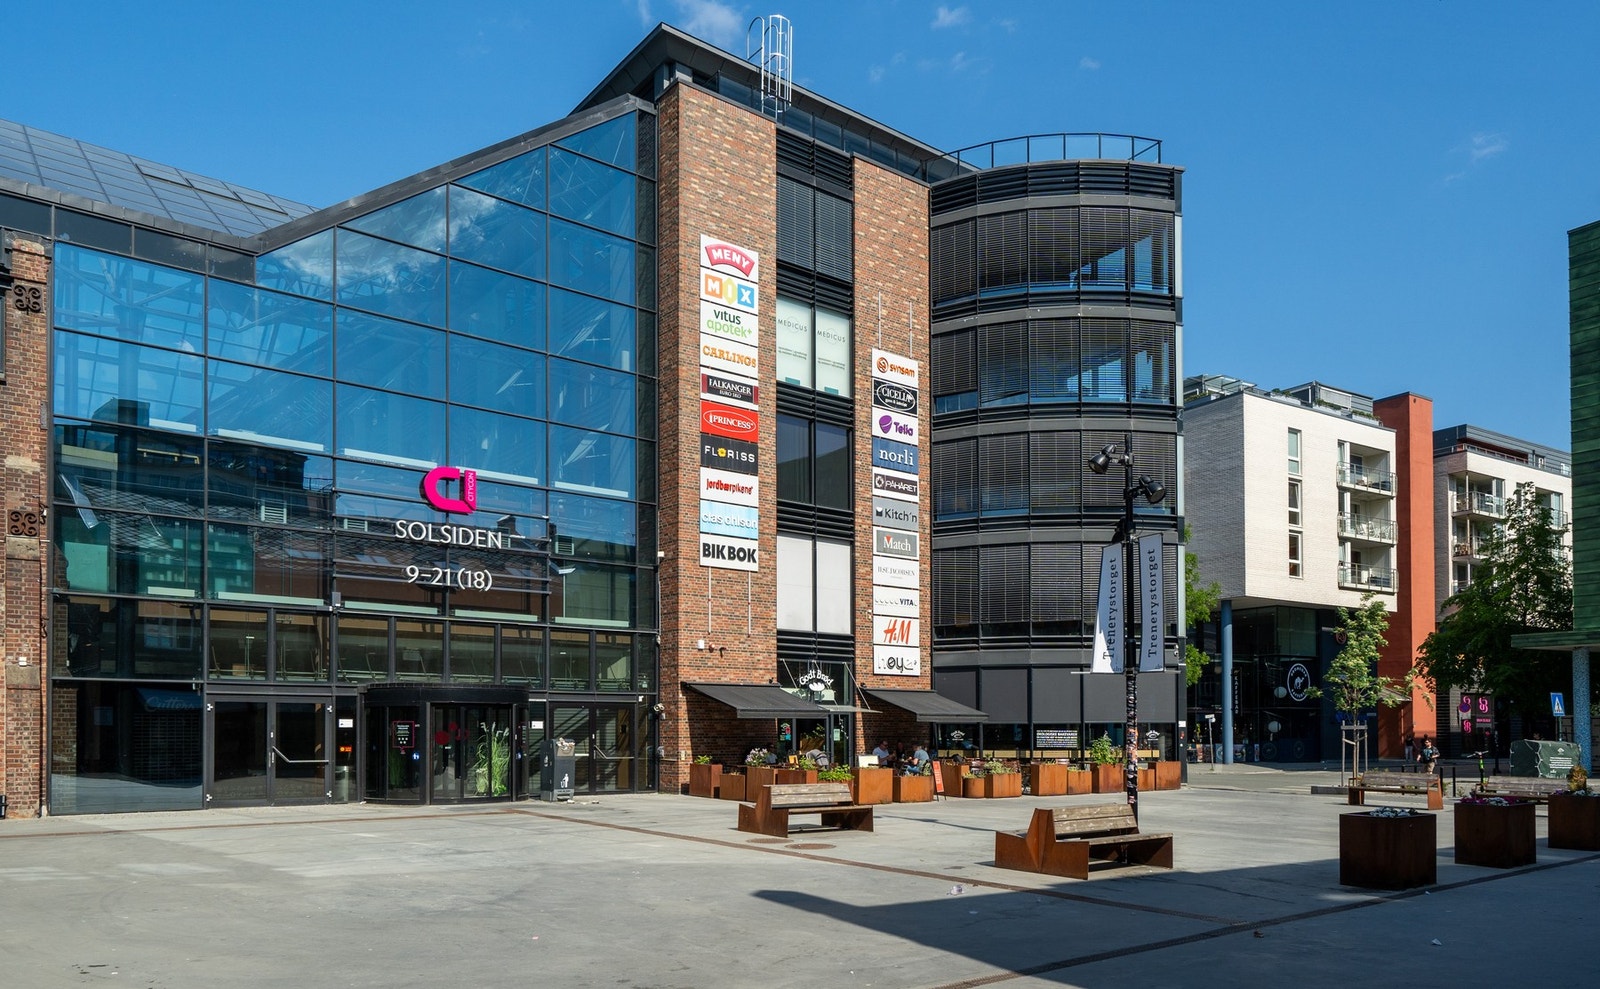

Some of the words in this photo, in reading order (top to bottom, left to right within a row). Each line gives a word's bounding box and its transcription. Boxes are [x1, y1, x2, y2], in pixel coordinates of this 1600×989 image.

[711, 248, 750, 269] MENY
[707, 277, 752, 305] MIX
[713, 309, 742, 325] vitus
[778, 318, 808, 332] MEDICUS
[817, 330, 846, 343] MEDICUS
[702, 345, 757, 368] CARLINGS
[709, 378, 752, 395] FALKANGER
[712, 414, 752, 430] PRINCESS
[893, 421, 914, 437] Telia
[704, 445, 755, 463] FLORISS
[879, 449, 914, 466] norli
[467, 472, 475, 501] CITYCON
[884, 508, 918, 523] Kitch'n
[395, 520, 502, 549] SOLSIDEN
[883, 535, 911, 551] Match
[702, 542, 727, 560] BIK
[727, 545, 757, 564] BOK
[457, 567, 493, 591] (18)
[1103, 557, 1118, 660] Trenerystorget
[1147, 549, 1159, 658] Trenerystorget
[883, 619, 912, 645] H&M
[799, 669, 816, 685] Godt
